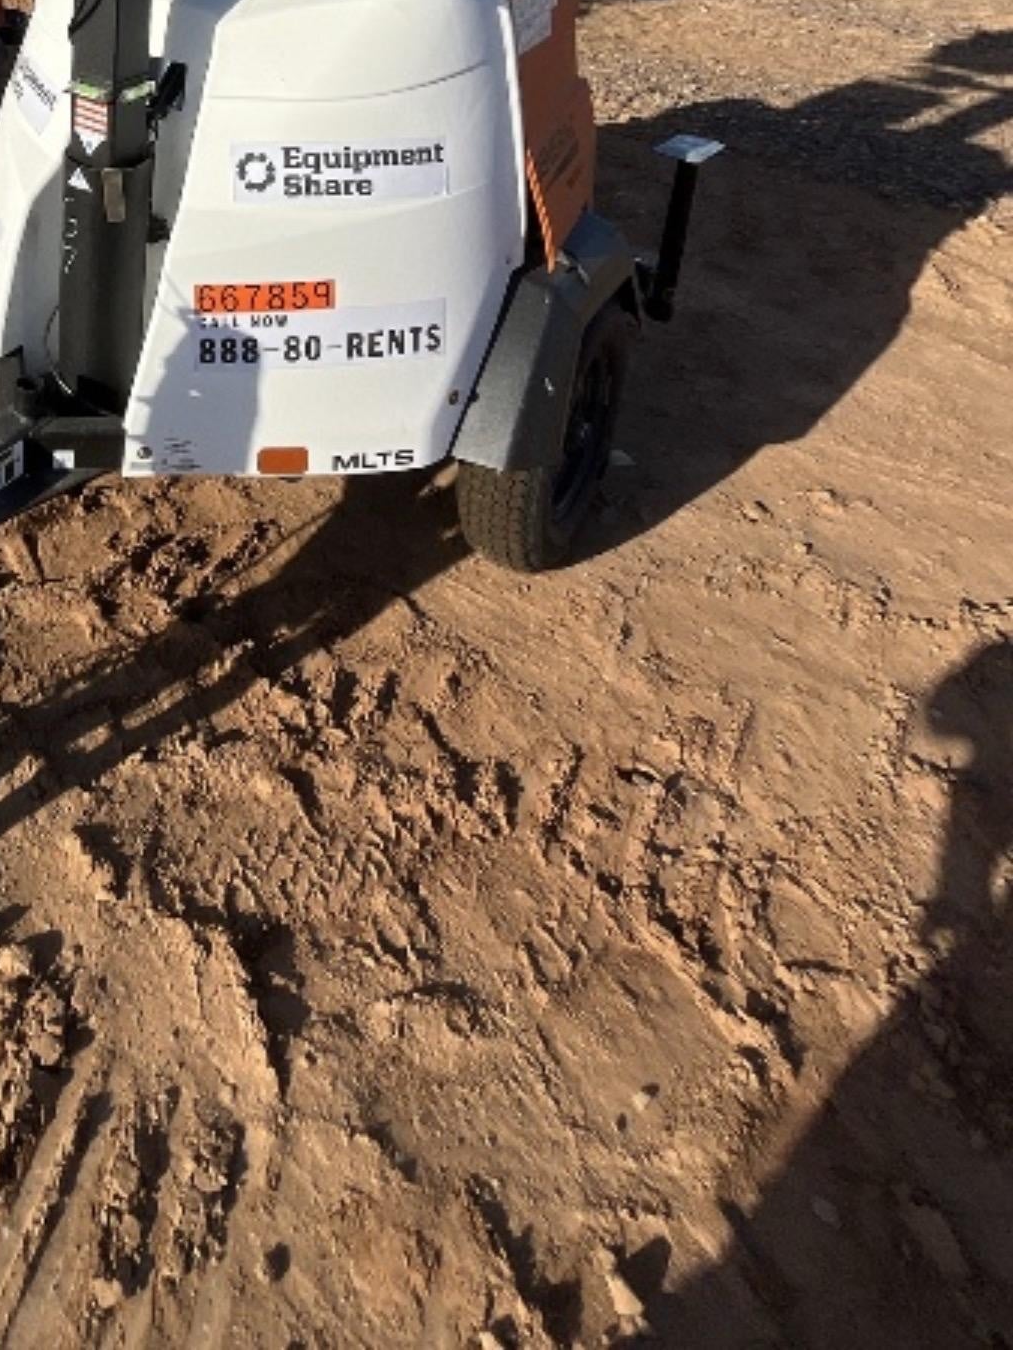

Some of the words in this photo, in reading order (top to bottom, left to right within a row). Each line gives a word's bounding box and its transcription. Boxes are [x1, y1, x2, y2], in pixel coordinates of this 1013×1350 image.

[280, 143, 445, 175] Equipment
[282, 174, 374, 198] Share
[198, 280, 333, 313] 667859
[199, 323, 443, 365] 888-80-RENTS
[331, 449, 416, 472] MLTS
